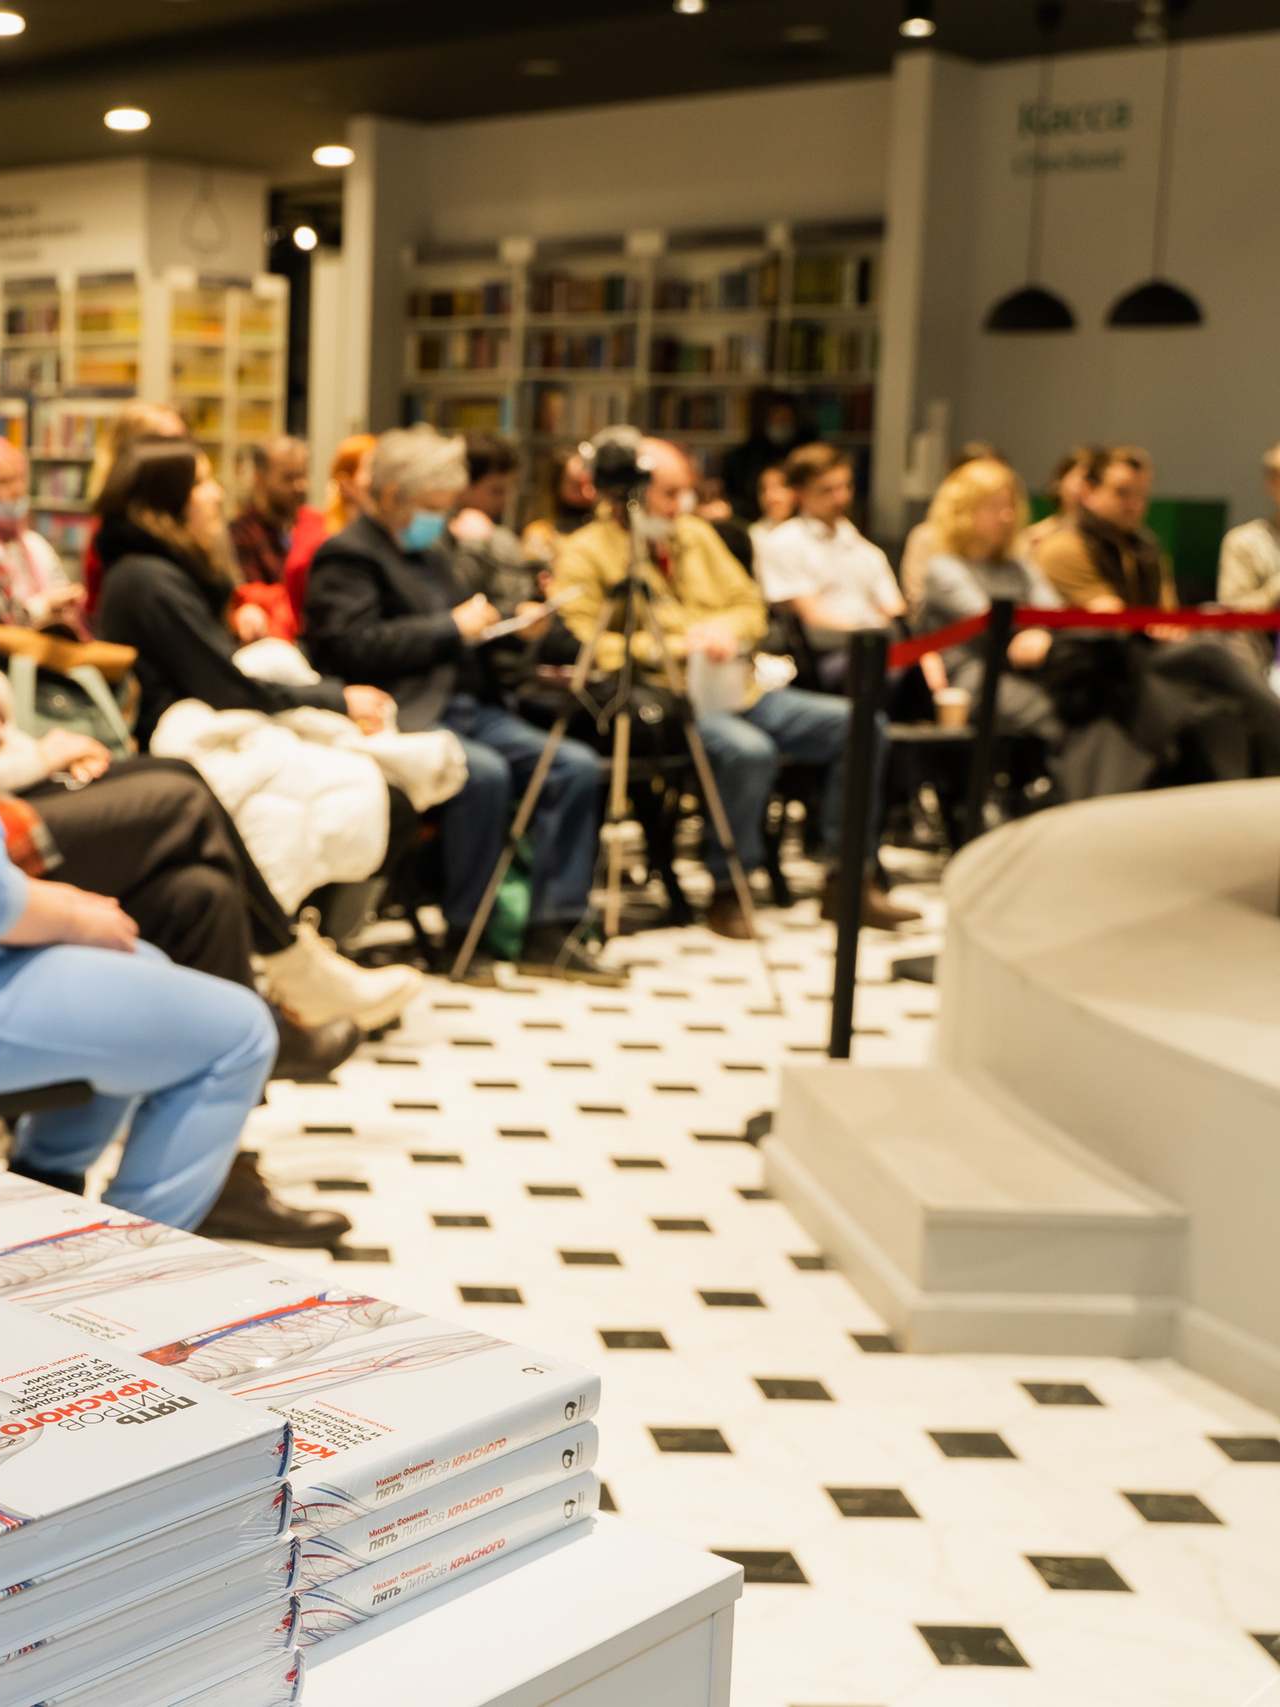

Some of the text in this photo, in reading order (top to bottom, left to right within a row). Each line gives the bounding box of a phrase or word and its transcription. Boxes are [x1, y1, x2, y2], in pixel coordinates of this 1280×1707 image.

[0, 1353, 89, 1382] Михаил Фоминых
[23, 1362, 85, 1386] лечении
[81, 1368, 124, 1382] знать
[9, 1373, 136, 1415] Что необходимо
[11, 1387, 65, 1405] крови,
[20, 1370, 93, 1395] болезнях
[0, 1379, 159, 1435] КРАСНОГО
[58, 1387, 175, 1431] ЛИТРОВ
[116, 1396, 198, 1424] ПЯТЬ
[288, 1408, 351, 1433] болезнях
[325, 1429, 362, 1445] знать
[354, 1433, 371, 1441] ее
[375, 1438, 506, 1501] ПЯТЬ ЛИТРОВ КРАСНОГО
[376, 1459, 434, 1488] Михаил Фоминых
[369, 1487, 503, 1552] ПЯТЬ ЛИТРОВ КРАСНОГО
[369, 1509, 429, 1539] Михаил Фоминых
[372, 1538, 506, 1606] ПЯТЬ ЛИТРОВ КРАСНОГО
[373, 1562, 432, 1592] Михаил Фоминых
